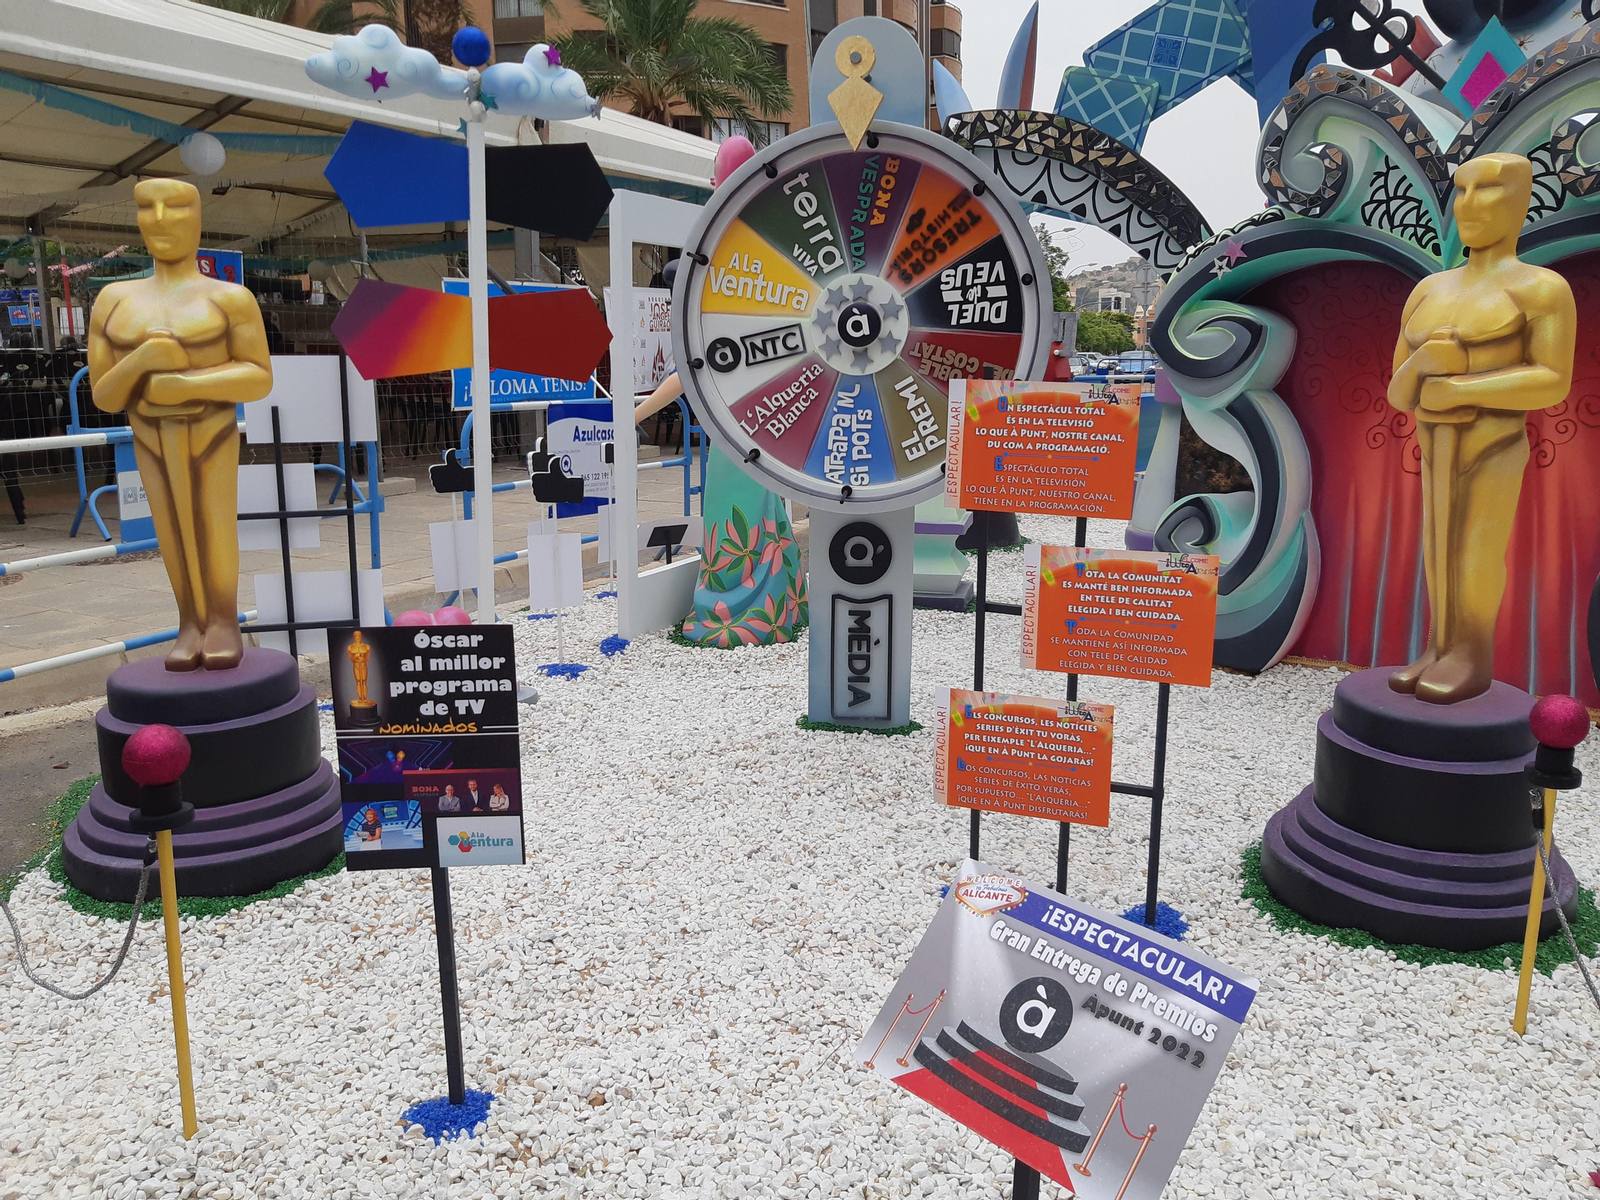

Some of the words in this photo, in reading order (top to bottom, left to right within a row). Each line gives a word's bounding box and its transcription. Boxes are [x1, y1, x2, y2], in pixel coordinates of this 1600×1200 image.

[870, 157, 900, 226] BONA
[783, 172, 844, 274] terra
[850, 155, 880, 273] VESPRADA
[899, 208, 983, 284] TRESORS
[729, 252, 740, 269] A
[743, 253, 763, 274] la
[940, 261, 1006, 291] VEUS
[709, 265, 810, 311] Ventura
[966, 285, 982, 304] de
[947, 300, 1007, 325] DUEL
[750, 332, 800, 359] NTC
[909, 341, 979, 373] COSTAT
[541, 377, 587, 394] TENIS!
[765, 385, 820, 440] Blanca
[894, 376, 946, 451] PREMI
[1075, 406, 1105, 416] TOTAL
[1006, 415, 1016, 424] ÉS
[1018, 417, 1030, 425] EN
[1033, 418, 1044, 426] LA
[1047, 417, 1094, 428] TELEVISIÓ
[976, 428, 987, 436] LO
[989, 428, 1008, 437] QUE
[1010, 426, 1018, 437] À
[1020, 429, 1048, 438] PUNT,
[1051, 432, 1087, 440] NOSTRE
[1090, 433, 1125, 442] CANAL,
[901, 429, 926, 462] EL
[947, 401, 962, 498] ¡ESPECTACULAR!
[1003, 441, 1024, 449] COM
[1036, 442, 1110, 454] PROGRAMACIÓ.
[996, 475, 1004, 483] ES
[1035, 477, 1086, 487] TELEVISIÓN
[1061, 467, 1089, 476] TOTAL
[966, 485, 976, 493] LO
[979, 486, 996, 494] QUE
[999, 483, 1006, 494] À
[1010, 487, 1036, 497] PUNT,
[1039, 490, 1080, 499] NUESTRO
[1083, 493, 1116, 502] CANAL,
[974, 497, 998, 506] TIENE
[1015, 499, 1026, 507] LA
[1029, 500, 1105, 513] PROGRAMACIÓN.
[1075, 563, 1105, 578] TOTA
[1107, 571, 1119, 579] LA
[1122, 571, 1182, 584] COMUNITAT
[1074, 581, 1107, 591] MANTÉ
[1111, 584, 1129, 592] BEN
[1132, 586, 1193, 597] INFORMADA
[1080, 594, 1092, 602] EN
[1095, 595, 1115, 603] TELE
[1118, 597, 1130, 605] DE
[1133, 598, 1173, 608] CALITAT
[1023, 565, 1038, 659] ¡ESPECTACULAR!
[1068, 605, 1106, 615] ELEGIDA
[1115, 608, 1133, 617] BEN
[1136, 610, 1184, 621] CUIDADA.
[414, 629, 484, 649] Óscar
[1065, 619, 1096, 636] TODA
[1113, 629, 1174, 642] COMUNIDAD
[1051, 636, 1059, 644] SE
[1062, 638, 1109, 648] MANTIENE
[1112, 641, 1127, 649] ASÍ
[1130, 643, 1187, 655] INFORMADA
[401, 655, 422, 672] al
[430, 654, 506, 671] millor
[1068, 650, 1087, 658] CON
[1090, 651, 1110, 660] TELE
[1113, 653, 1124, 661] DE
[1127, 654, 1168, 665] CALIDAD
[1059, 660, 1095, 670] ELEGIDA
[1107, 664, 1127, 672] BIEN
[1130, 666, 1175, 678] CUIDADA.
[390, 678, 513, 697] programa
[419, 700, 449, 716] de
[455, 699, 485, 715] TV
[965, 704, 981, 719] ELS
[983, 713, 1038, 725] CONCURSOS,
[1040, 719, 1054, 728] LES
[965, 733, 980, 741] PER
[983, 735, 1024, 746] EIXEMPLE
[976, 723, 1004, 733] SERIES
[1036, 729, 1047, 737] TU
[935, 706, 947, 795] ¡ESPECTACULAR!
[966, 744, 985, 754] ¡QUE
[988, 746, 999, 754] EN
[1002, 744, 1009, 755] À
[1011, 749, 1035, 758] PUNT
[1037, 752, 1048, 760] LA
[957, 757, 976, 772] LOS
[979, 766, 1030, 780] CONCURSOS,
[1033, 773, 1048, 781] LAS
[1050, 776, 1091, 787] NOTICIAS
[974, 776, 1000, 785] SERIES
[1003, 779, 1013, 787] DE
[958, 796, 977, 806] ¡QUE
[980, 798, 991, 806] EN
[993, 798, 1000, 807] À
[1004, 801, 1025, 810] PUNT
[460, 834, 514, 847] Ventura
[967, 876, 1021, 887] WELCOME
[983, 884, 1008, 892] Fabulous
[962, 889, 1013, 902] ALICANTE
[1041, 904, 1234, 1005] ¡ESPECTACULAR!
[989, 920, 1032, 953] Gran
[1030, 937, 1102, 986] Entrega
[1103, 972, 1126, 997] de
[1129, 981, 1218, 1043] Premios
[1081, 993, 1145, 1036] Àpunt
[1147, 1027, 1206, 1068] 2022
